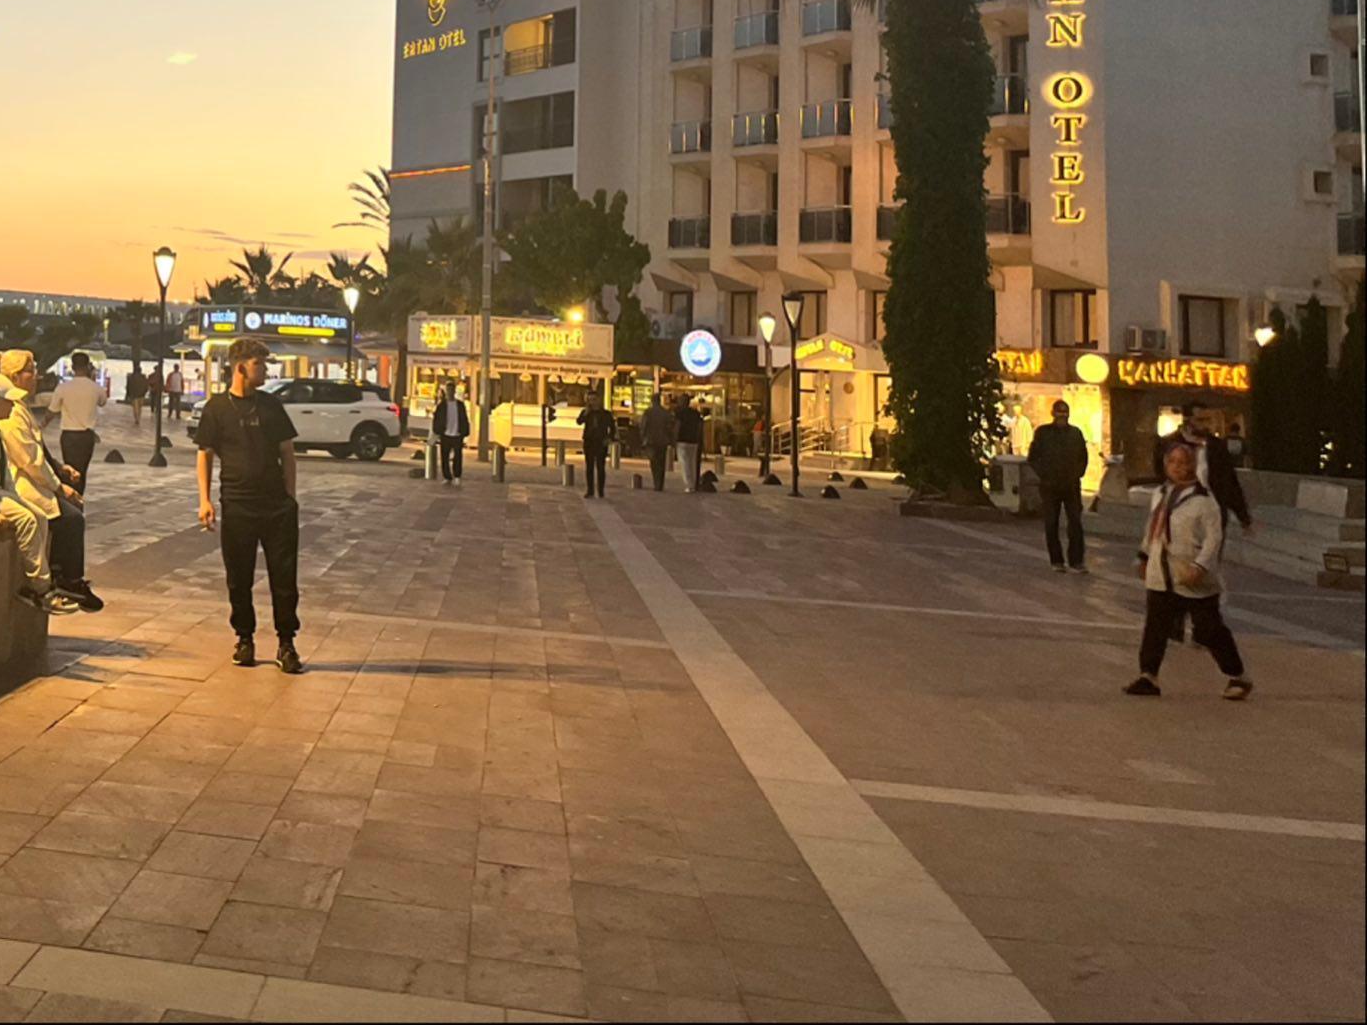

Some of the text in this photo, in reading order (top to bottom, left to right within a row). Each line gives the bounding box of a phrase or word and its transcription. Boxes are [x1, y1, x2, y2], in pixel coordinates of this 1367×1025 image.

[439, 28, 466, 51] OTEL
[1045, 73, 1090, 223] OTEL
[313, 313, 347, 329] DÖNER
[1117, 359, 1251, 390] MANHATTAN
